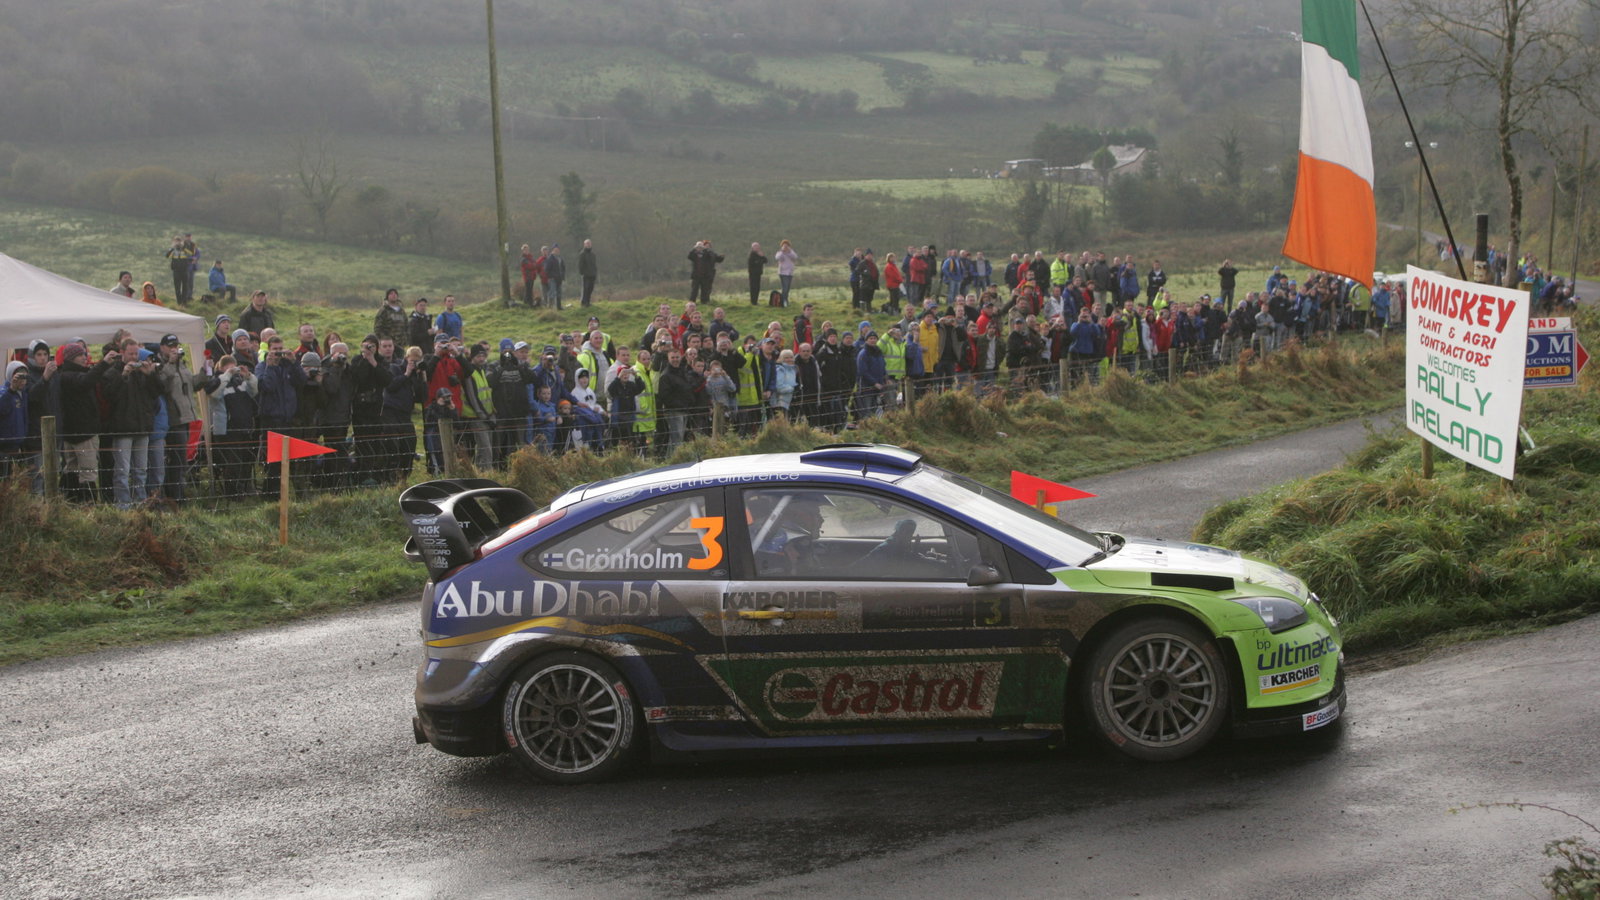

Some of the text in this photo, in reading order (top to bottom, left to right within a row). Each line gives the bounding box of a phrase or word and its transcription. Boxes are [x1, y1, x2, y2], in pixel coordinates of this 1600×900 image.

[1411, 276, 1517, 334] COMISKEY
[1418, 315, 1497, 350] PLANT & AGRI
[1547, 335, 1571, 355] M
[1420, 334, 1492, 368] CONTRACTORS
[1526, 356, 1571, 366] UCTIONS
[1427, 352, 1476, 383] WELCOMES
[1525, 367, 1567, 377] FOR SALE
[1418, 364, 1492, 416] RALLY
[1411, 399, 1503, 464] IRELAND
[418, 525, 440, 534] NGK
[687, 516, 725, 571] 3
[566, 548, 683, 571] Grönholm
[436, 580, 661, 618] Abu Dhabi
[723, 591, 837, 609] KÄRCHER
[921, 605, 963, 617] Ireland
[983, 597, 1003, 625] 3
[1256, 638, 1271, 651] bp
[1271, 664, 1320, 686] KÄRCHER
[821, 670, 986, 716] Castrol
